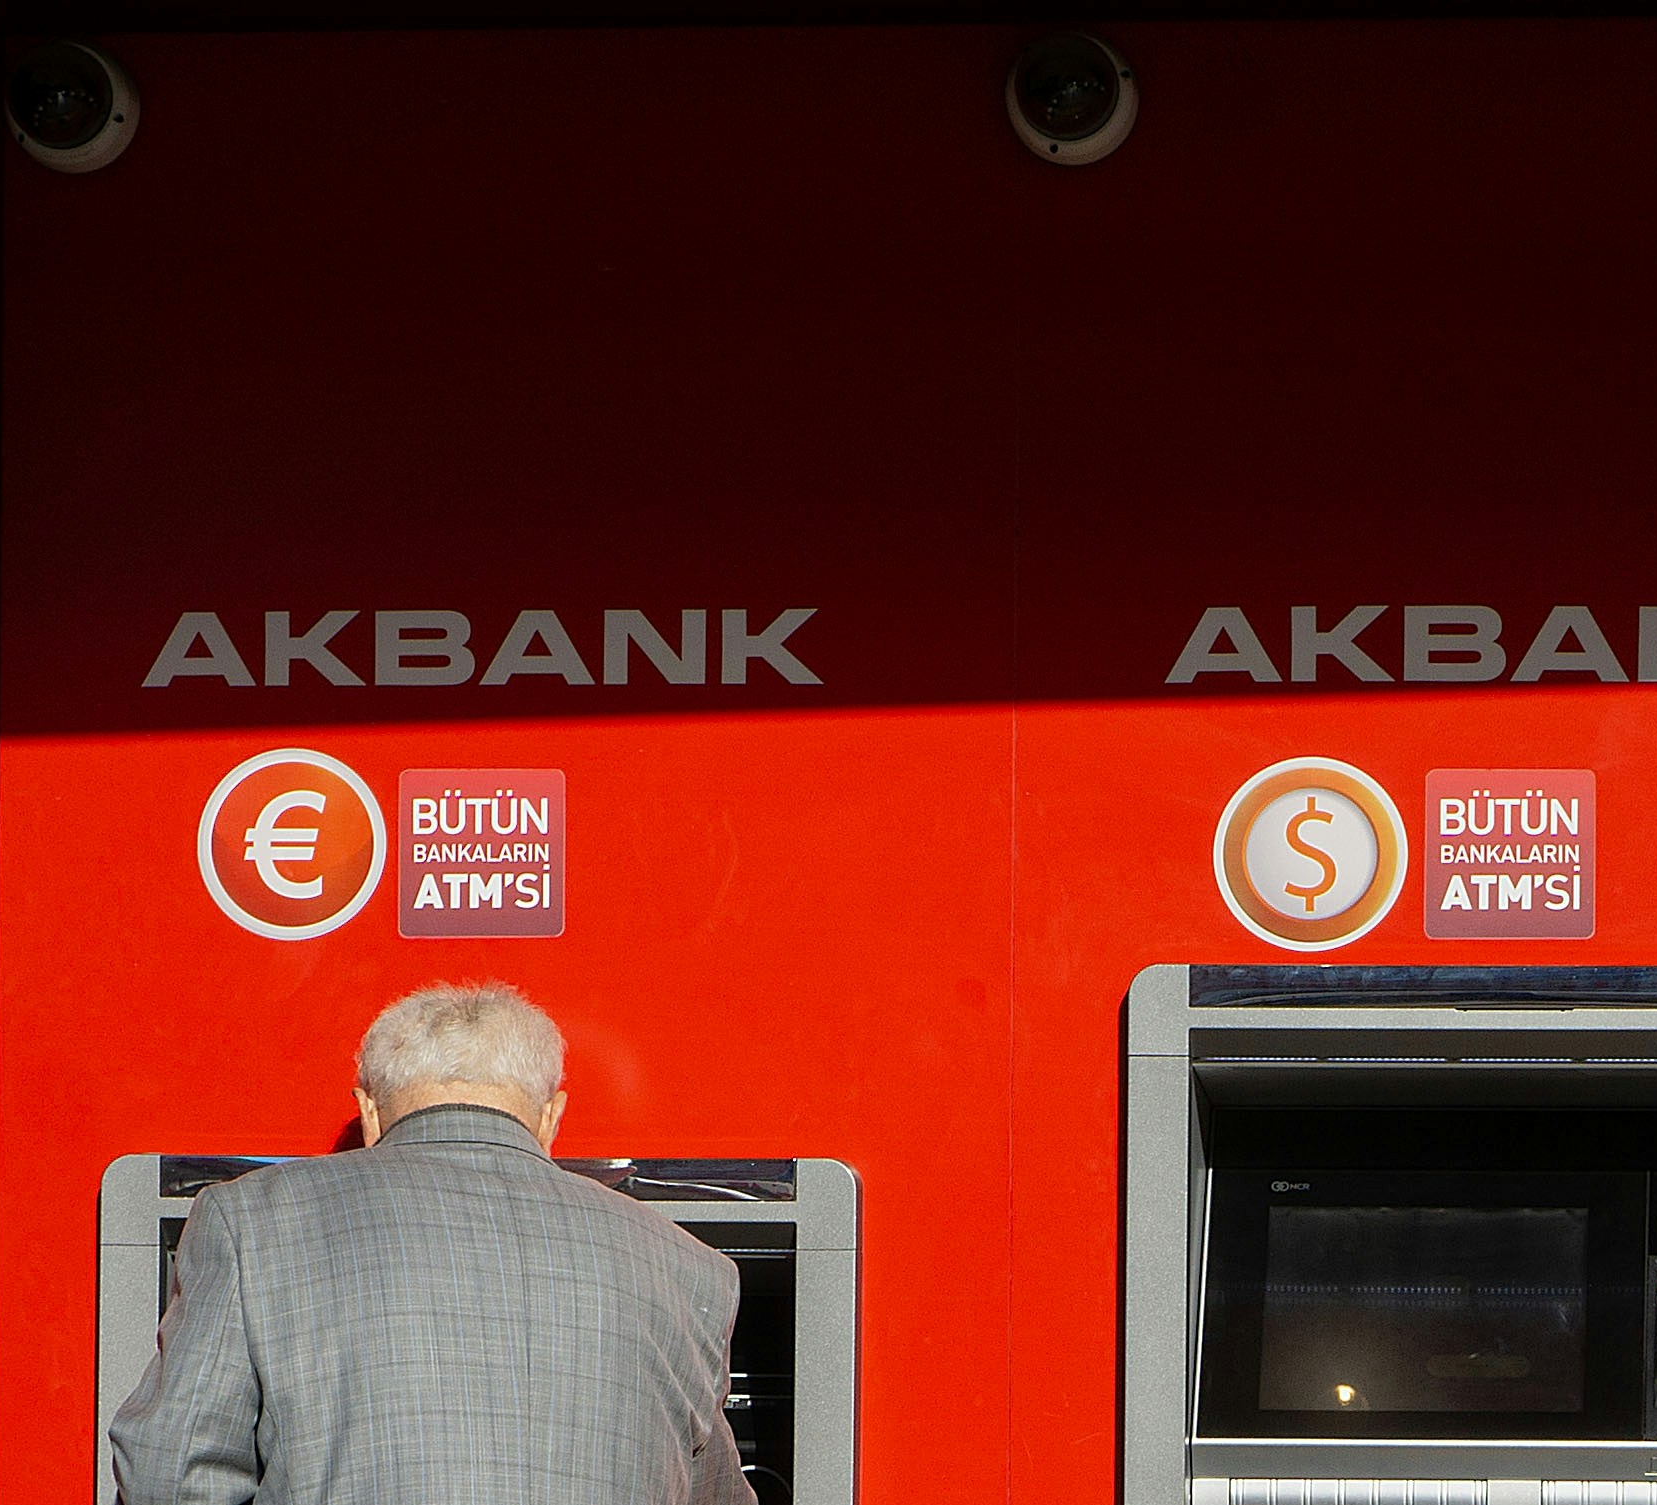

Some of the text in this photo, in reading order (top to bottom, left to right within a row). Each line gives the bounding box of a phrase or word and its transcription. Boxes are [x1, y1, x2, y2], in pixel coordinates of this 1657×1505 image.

[140, 608, 824, 687] AKBANK
[411, 789, 549, 836] BÜTÜN
[1440, 789, 1580, 837] BÜTÜN
[412, 844, 550, 864] BANKALARIN
[1440, 845, 1580, 865] BANKALARIN
[413, 864, 552, 910] ATM'Sİ
[1440, 865, 1582, 912] ATM'Sİ
